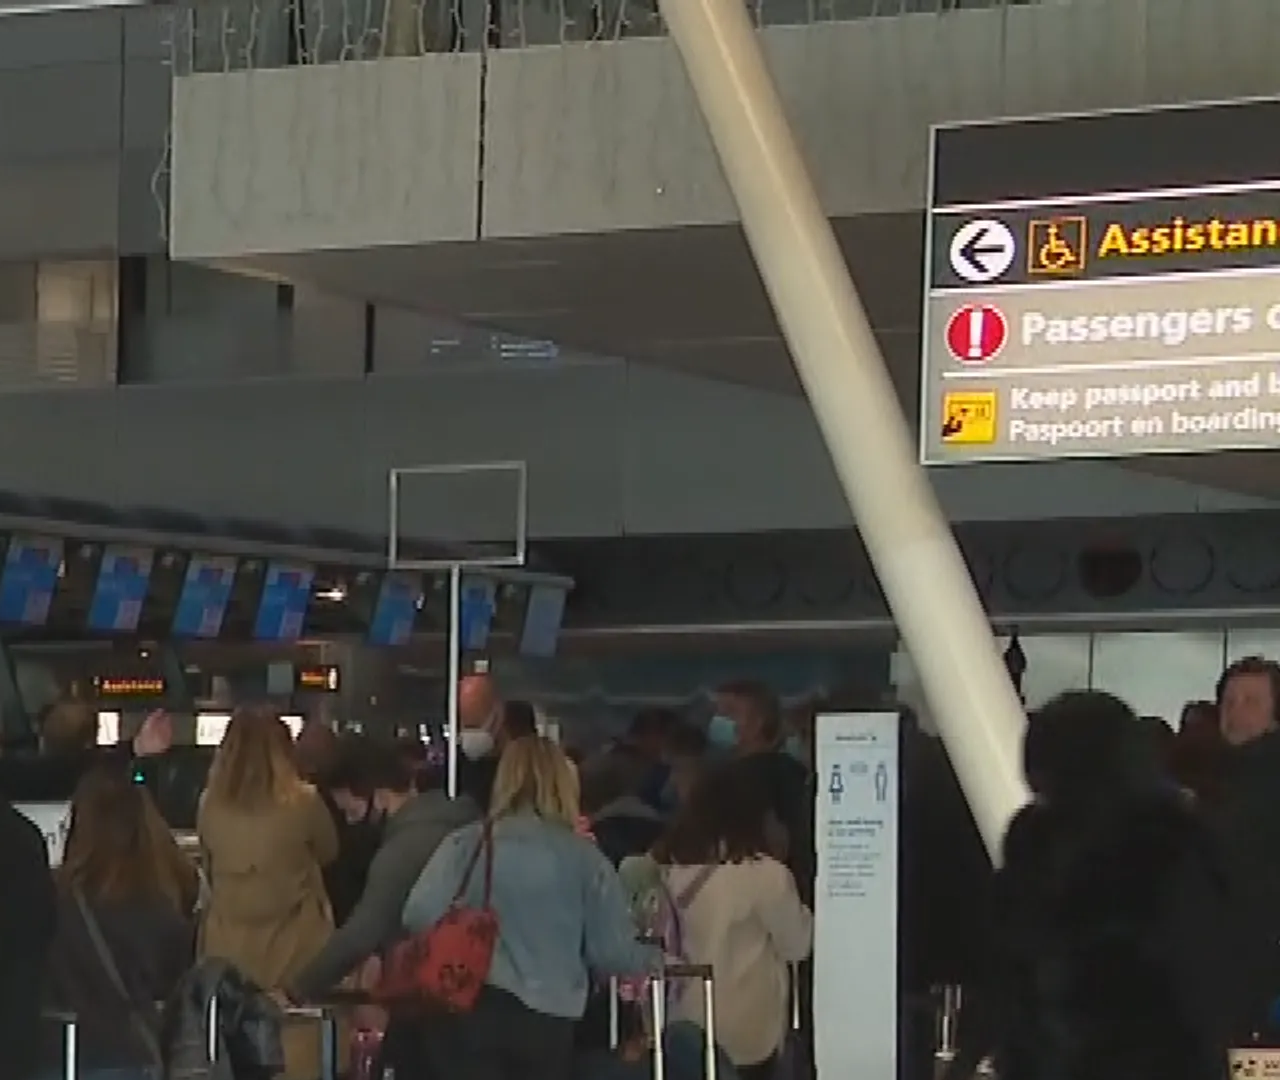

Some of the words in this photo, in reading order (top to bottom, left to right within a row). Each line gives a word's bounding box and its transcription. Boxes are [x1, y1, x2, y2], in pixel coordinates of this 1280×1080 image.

[1098, 217, 1280, 258] Assistan
[1021, 305, 1252, 346] Passengers
[1011, 387, 1078, 411] Keep
[1085, 376, 1202, 411] passport
[1208, 371, 1259, 398] and
[1009, 413, 1124, 445] Paspoort
[1132, 413, 1163, 435] en
[1171, 405, 1280, 436] boardin
